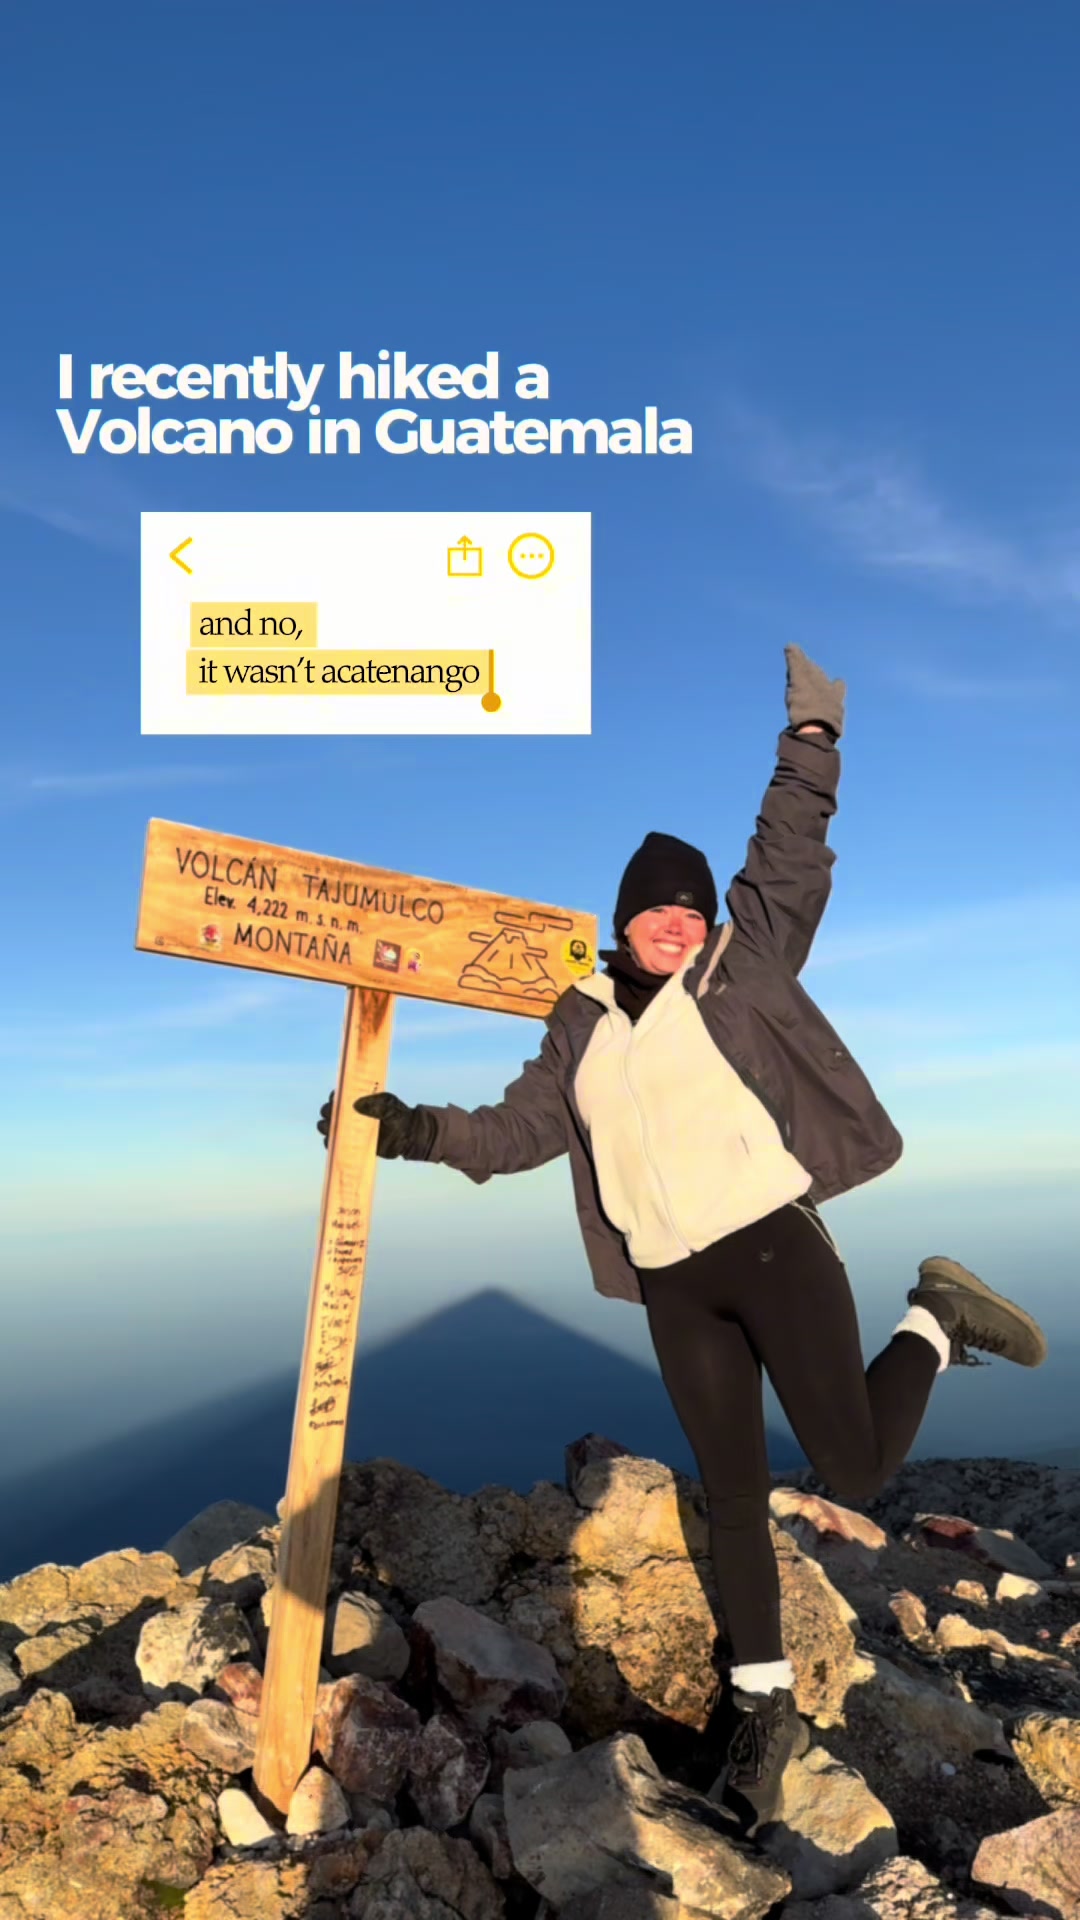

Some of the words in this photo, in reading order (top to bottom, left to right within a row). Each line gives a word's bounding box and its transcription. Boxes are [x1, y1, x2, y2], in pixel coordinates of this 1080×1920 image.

[175, 847, 278, 893] VOLCÁN
[302, 873, 445, 925] TAJUMULCO
[203, 885, 237, 909] Elev.
[246, 895, 289, 920] 4,222
[233, 922, 353, 966] MONTAÑA
